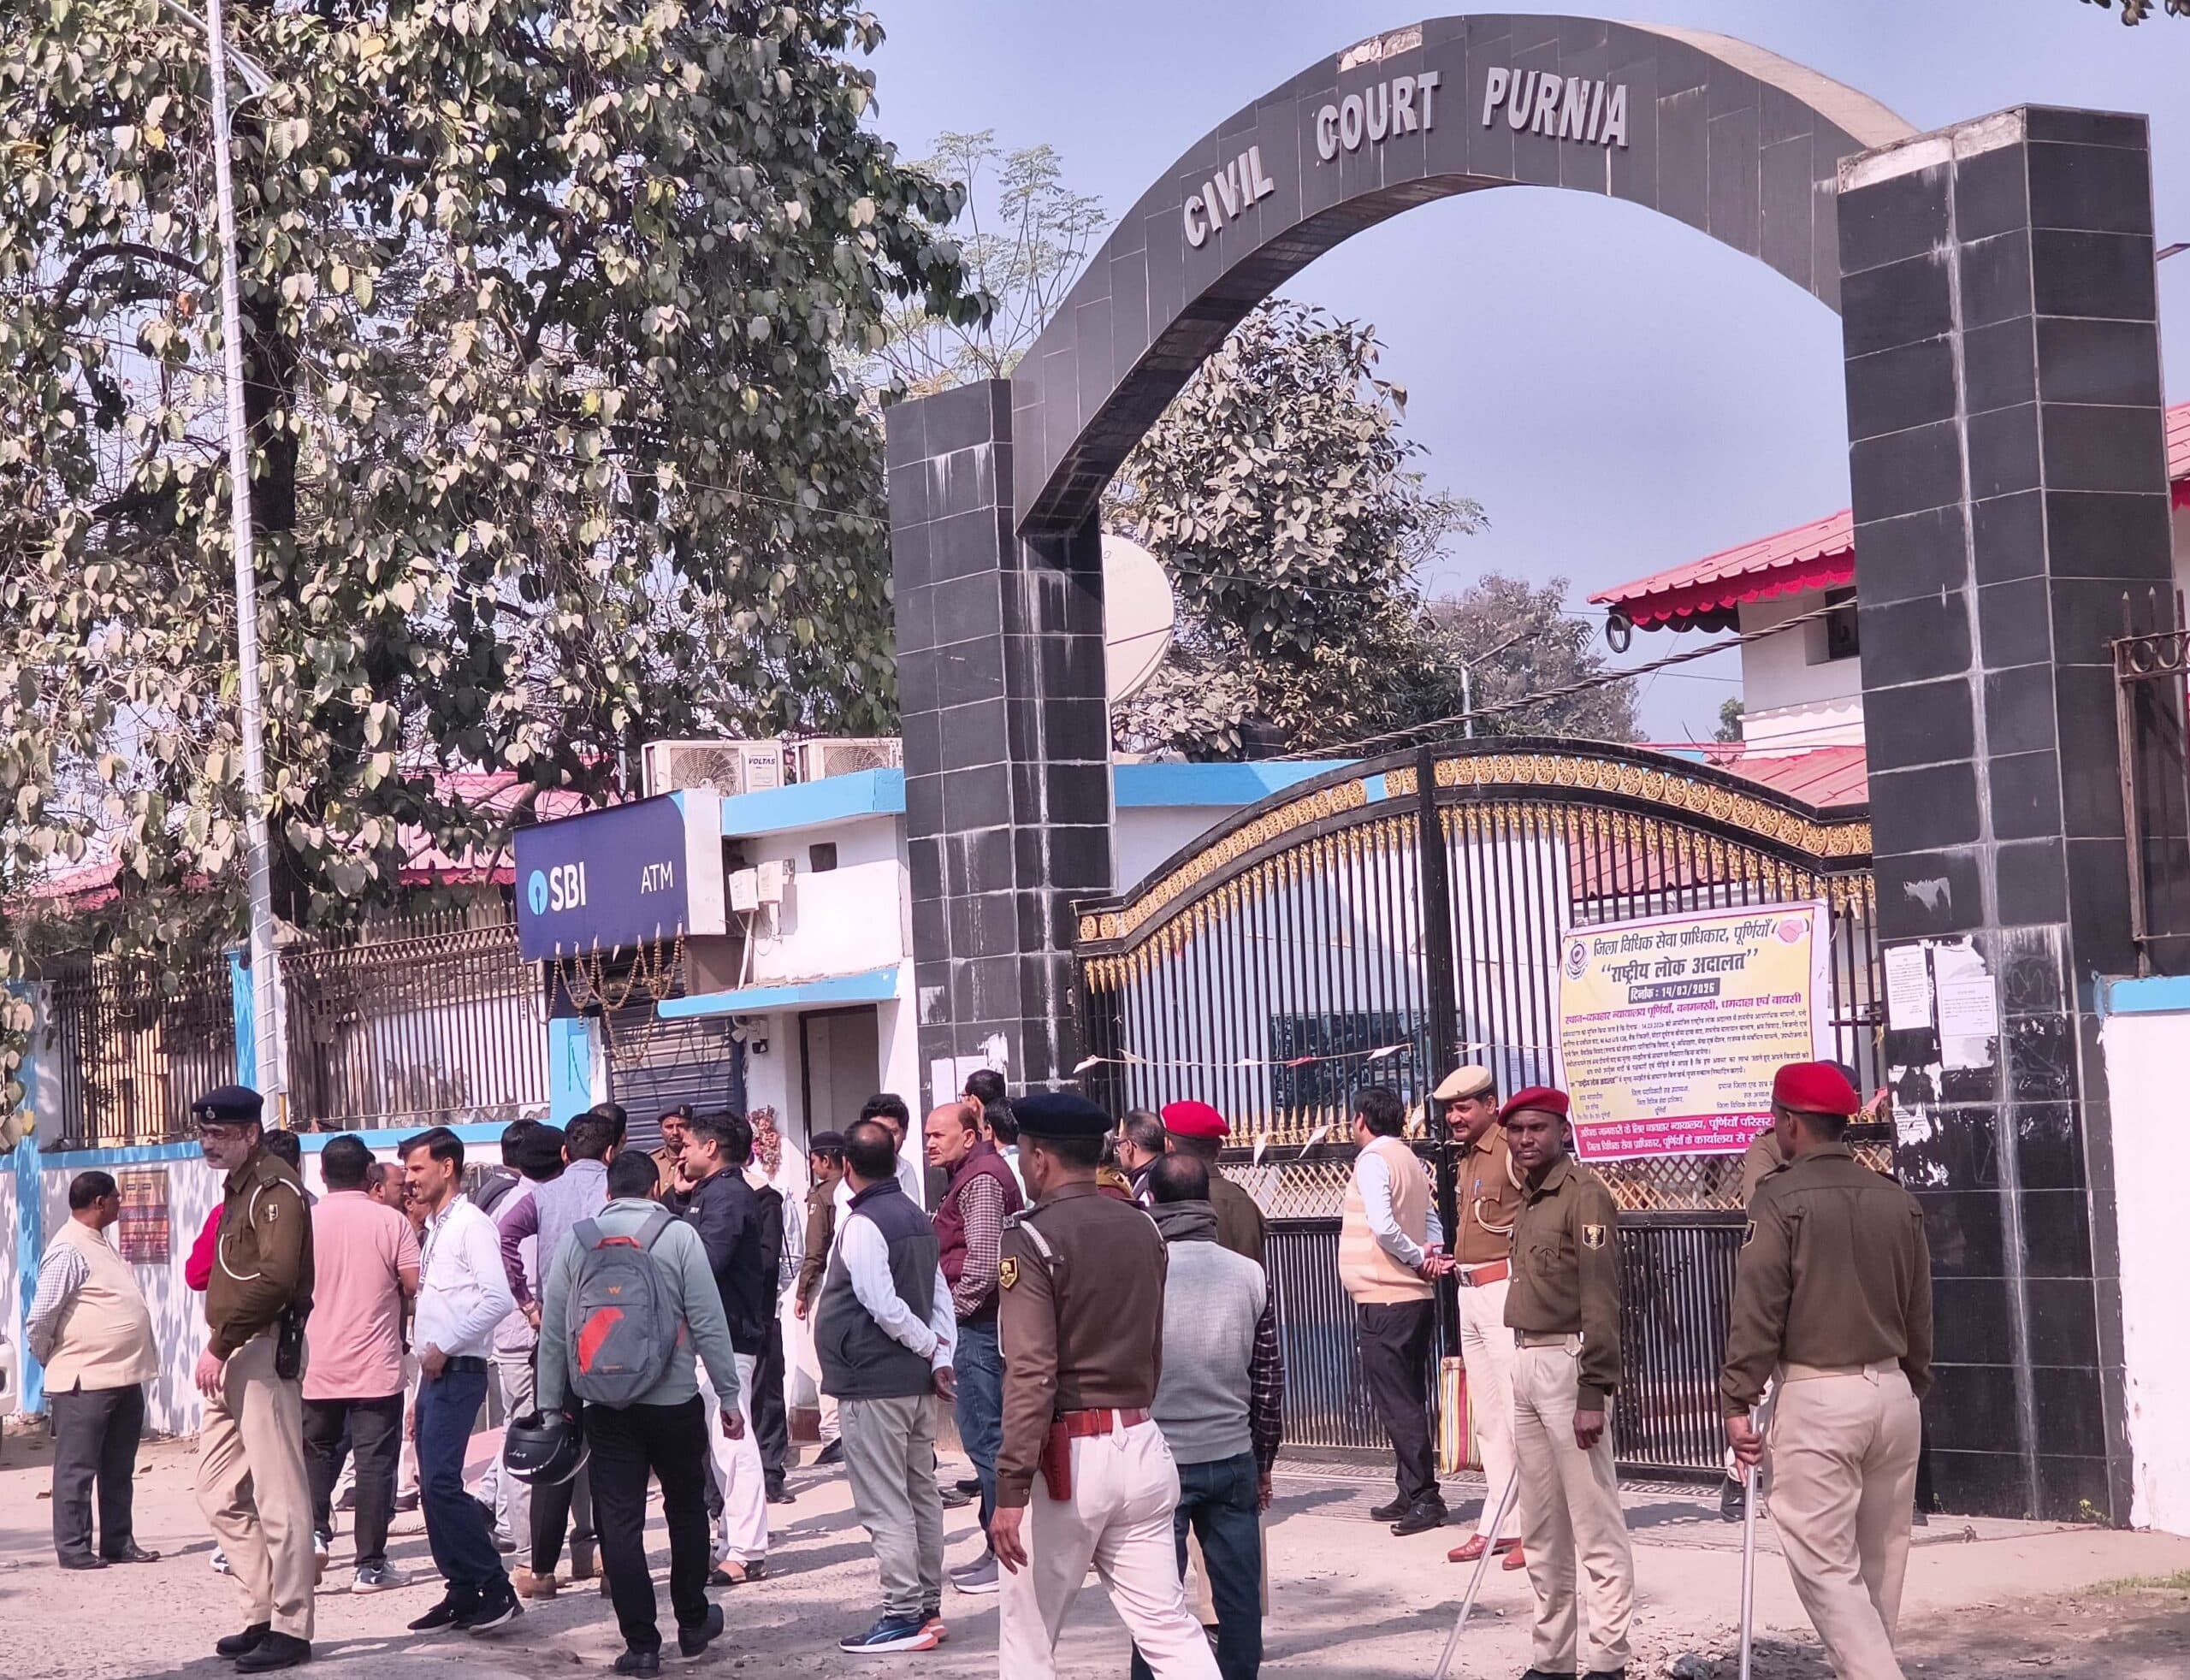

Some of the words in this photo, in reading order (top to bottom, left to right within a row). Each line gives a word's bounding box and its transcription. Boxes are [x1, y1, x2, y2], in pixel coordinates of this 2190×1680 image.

[1183, 145, 1274, 247] CIVIL
[1316, 71, 1441, 160] COURT
[1482, 67, 1629, 146] PURNIA
[550, 861, 587, 911] SBI
[641, 861, 673, 894] ATM
[1594, 938, 1619, 956] जिला
[1620, 933, 1654, 953] विधिक
[1655, 931, 1678, 949] सेवा
[1680, 926, 1729, 948] प्राधिकार,
[1654, 956, 1687, 978] लोक
[1661, 982, 1714, 998] 14/03/2026
[1756, 993, 1770, 1006] एवं
[1740, 1115, 1771, 1127] परिसर
[1694, 1132, 1733, 1144] कार्यालय
[1736, 1131, 1745, 1143] से
